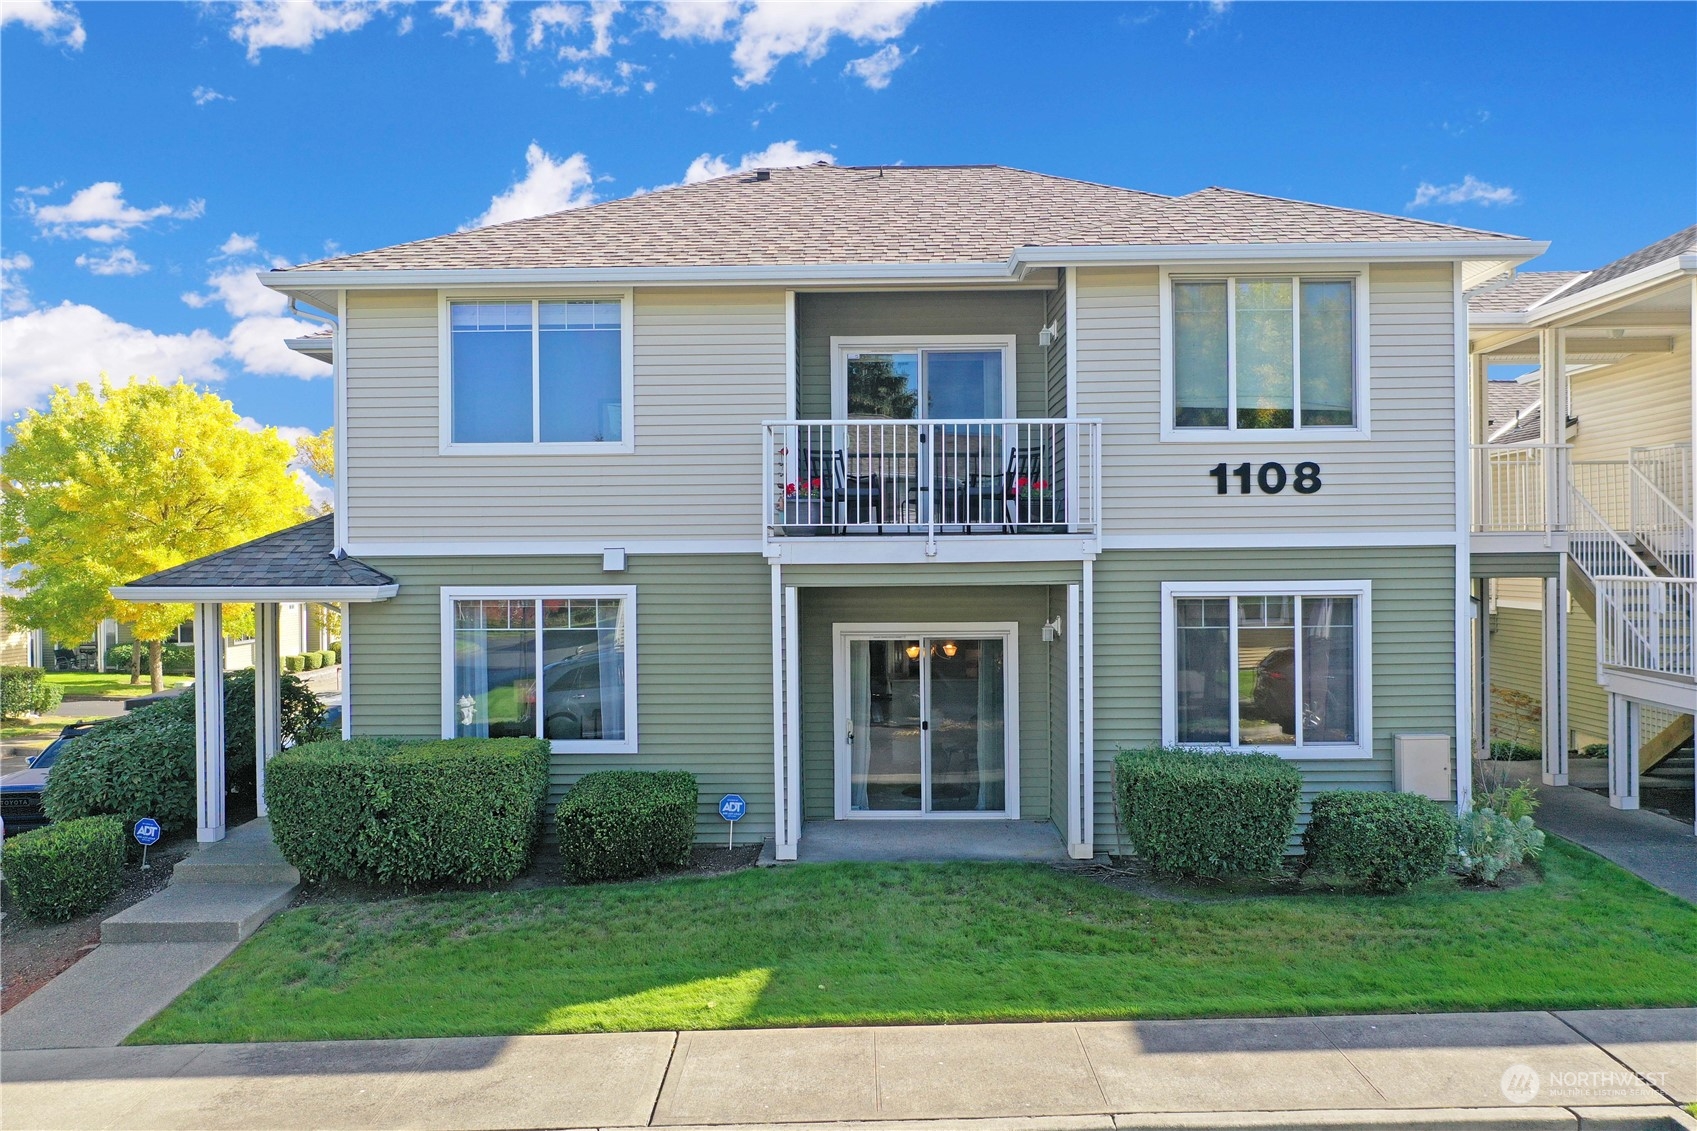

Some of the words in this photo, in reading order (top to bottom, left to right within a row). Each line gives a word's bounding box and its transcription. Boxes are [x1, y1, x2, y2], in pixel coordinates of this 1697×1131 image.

[1209, 461, 1322, 495] 1108
[722, 801, 743, 812] ADT
[136, 825, 158, 837] ADT
